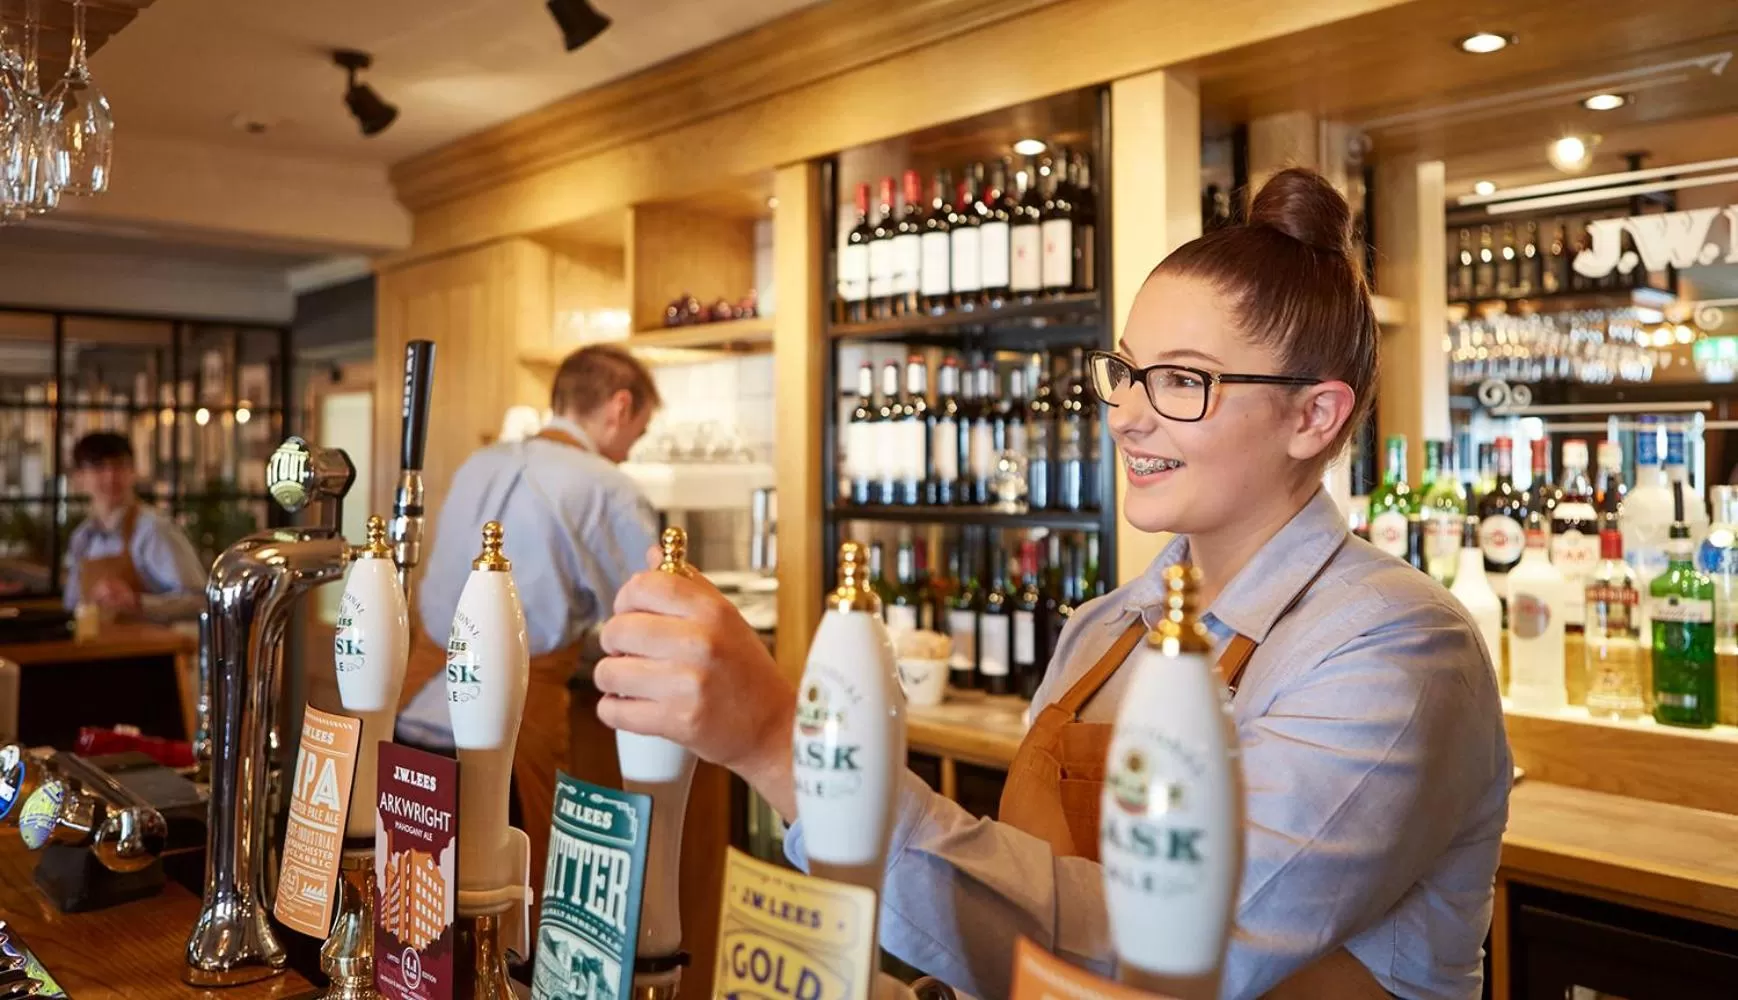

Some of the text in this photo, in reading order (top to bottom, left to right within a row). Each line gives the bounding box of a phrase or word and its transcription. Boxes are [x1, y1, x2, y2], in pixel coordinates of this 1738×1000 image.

[380, 791, 451, 833] ARKWRIGHT
[423, 831, 433, 842] ALE
[543, 825, 631, 935] ITTER
[733, 943, 822, 1000] GOLD
